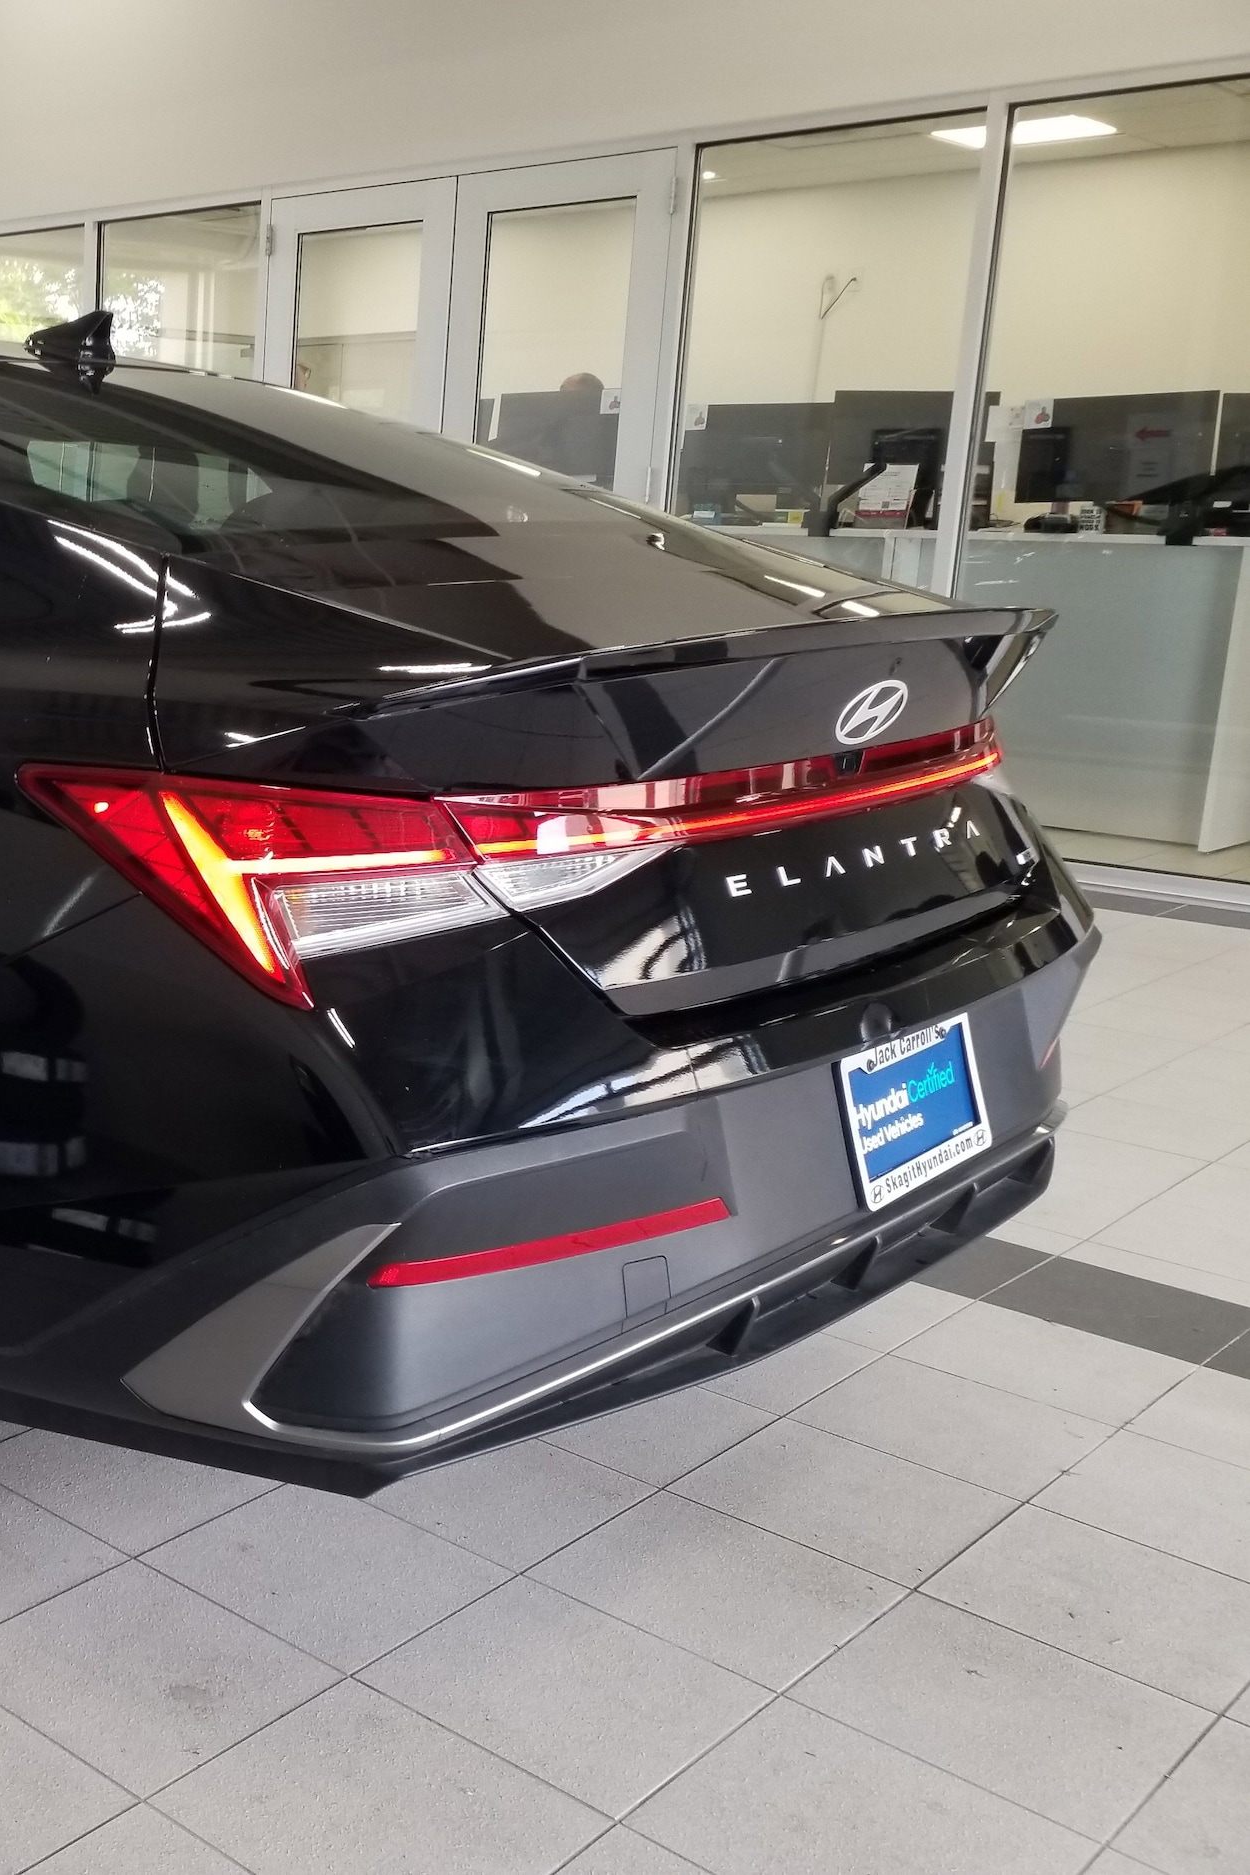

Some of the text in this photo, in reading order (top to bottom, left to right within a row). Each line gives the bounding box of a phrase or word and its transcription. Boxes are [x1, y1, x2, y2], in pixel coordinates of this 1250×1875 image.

[725, 820, 980, 897] ELANTRA
[873, 1041, 897, 1067] Jack
[884, 1113, 924, 1141] Vehicles
[885, 1137, 973, 1193] SkagitHyundai.com
